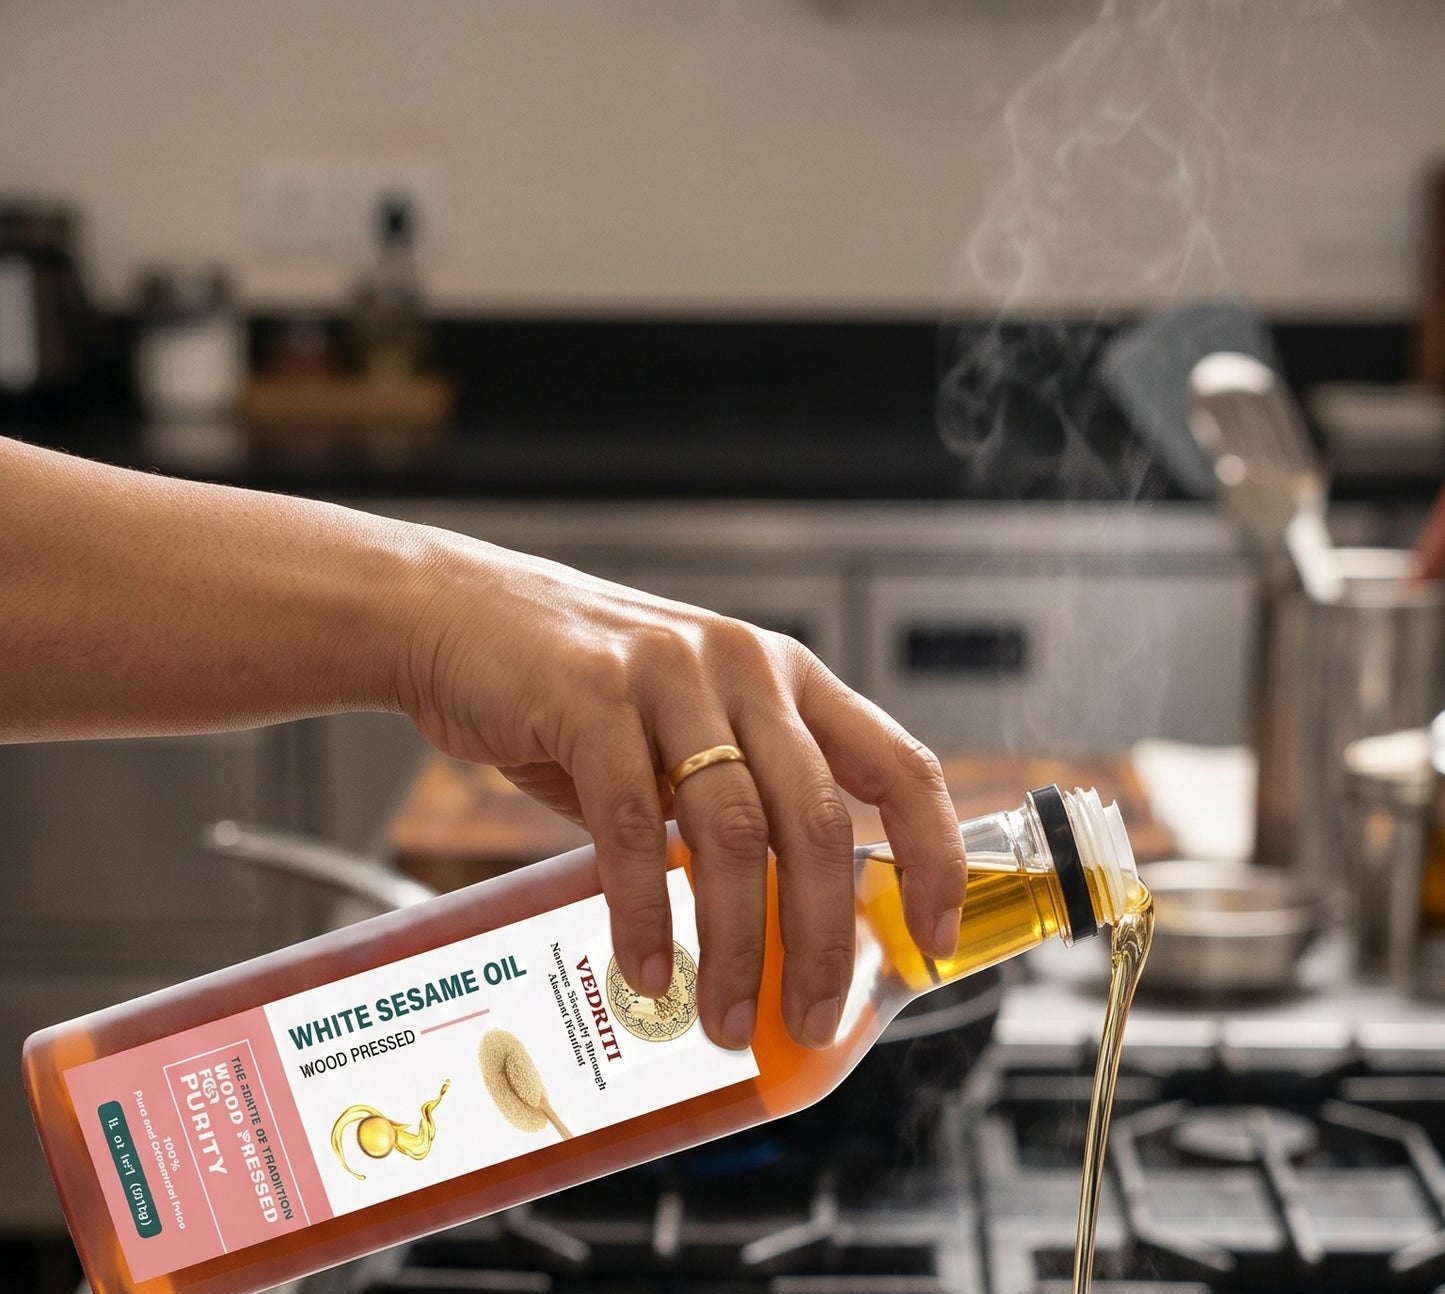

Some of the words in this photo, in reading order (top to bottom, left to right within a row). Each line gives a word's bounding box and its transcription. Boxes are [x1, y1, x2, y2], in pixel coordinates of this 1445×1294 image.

[288, 1004, 373, 1050] WHITE
[375, 969, 480, 1022] SESAME
[483, 955, 527, 986] OIL
[576, 955, 622, 1062] VEDRITI
[231, 1056, 246, 1082] THE
[299, 1052, 348, 1079] WOOD
[350, 1029, 416, 1063] PRESSED
[163, 1137, 181, 1172] 100%
[180, 1072, 228, 1175] PURITY
[214, 1062, 244, 1125] WOOD
[237, 1129, 279, 1223] PRESSED
